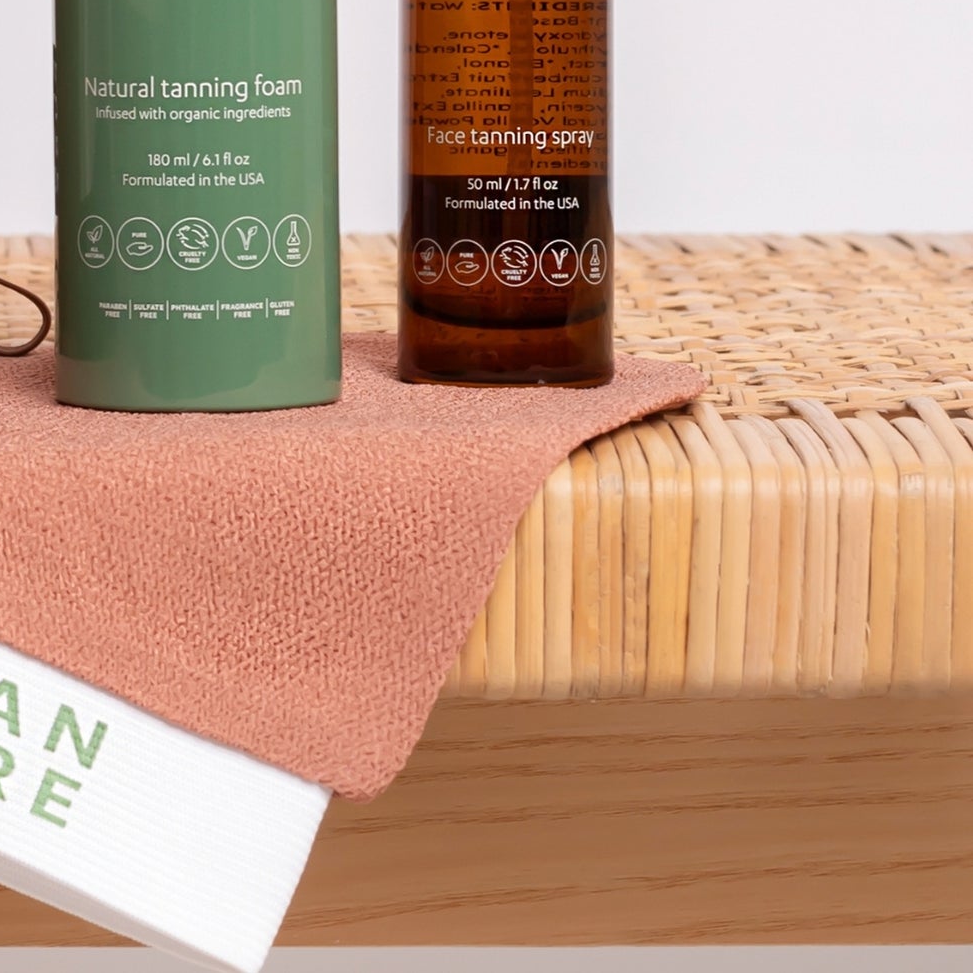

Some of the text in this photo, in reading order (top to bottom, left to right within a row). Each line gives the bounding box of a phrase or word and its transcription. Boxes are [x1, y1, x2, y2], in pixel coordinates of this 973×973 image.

[84, 74, 302, 103] Natural tanning foam
[95, 105, 291, 123] Infused with organic ingredients
[427, 126, 465, 144] Face
[470, 127, 547, 149] tanning
[552, 129, 594, 148] spray
[147, 152, 250, 167] 180 ml / 6.1 fl oz
[122, 173, 265, 187] Formulated in the USA
[467, 177, 558, 191] 50 ml / 1.7 fl oz
[445, 197, 580, 210] Formulated in the USA
[221, 302, 264, 310] FRAGRANCE
